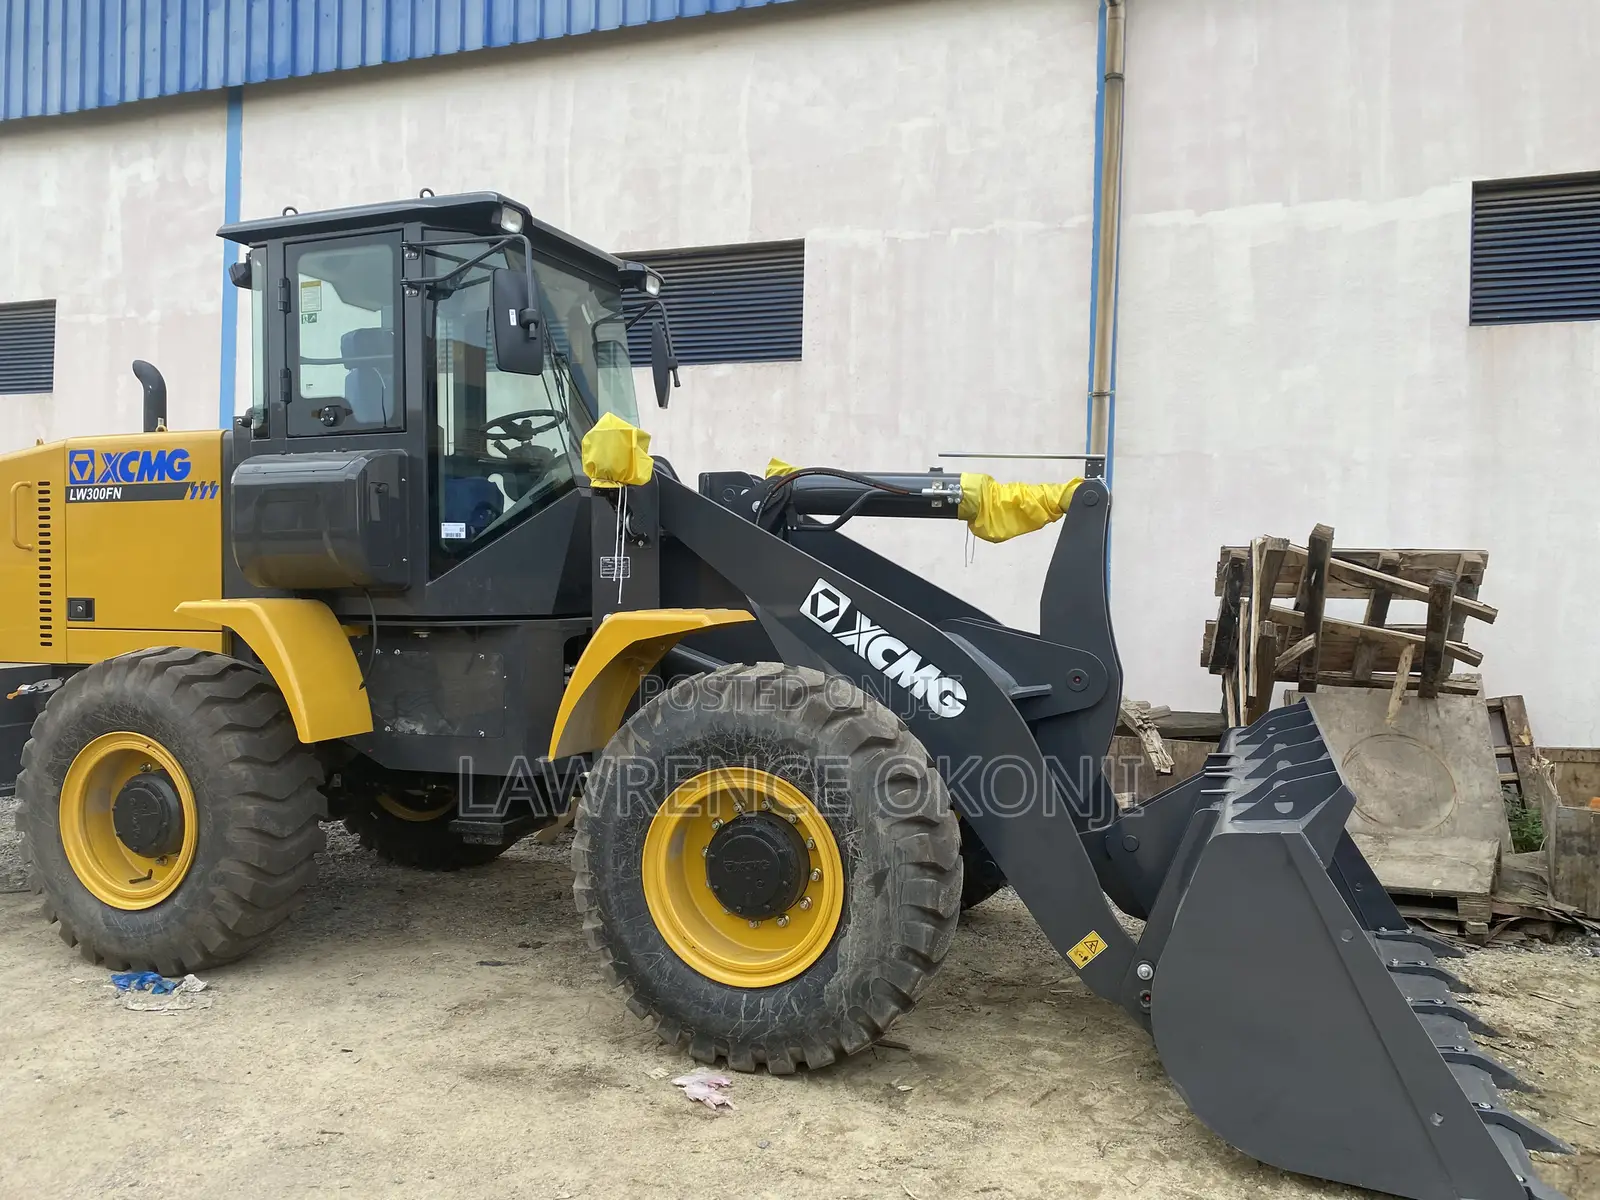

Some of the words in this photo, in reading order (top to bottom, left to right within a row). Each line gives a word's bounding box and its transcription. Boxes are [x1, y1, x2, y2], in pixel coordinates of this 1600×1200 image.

[96, 449, 191, 483] XCMG
[69, 487, 122, 500] LW300FN
[832, 610, 967, 718] XCMG
